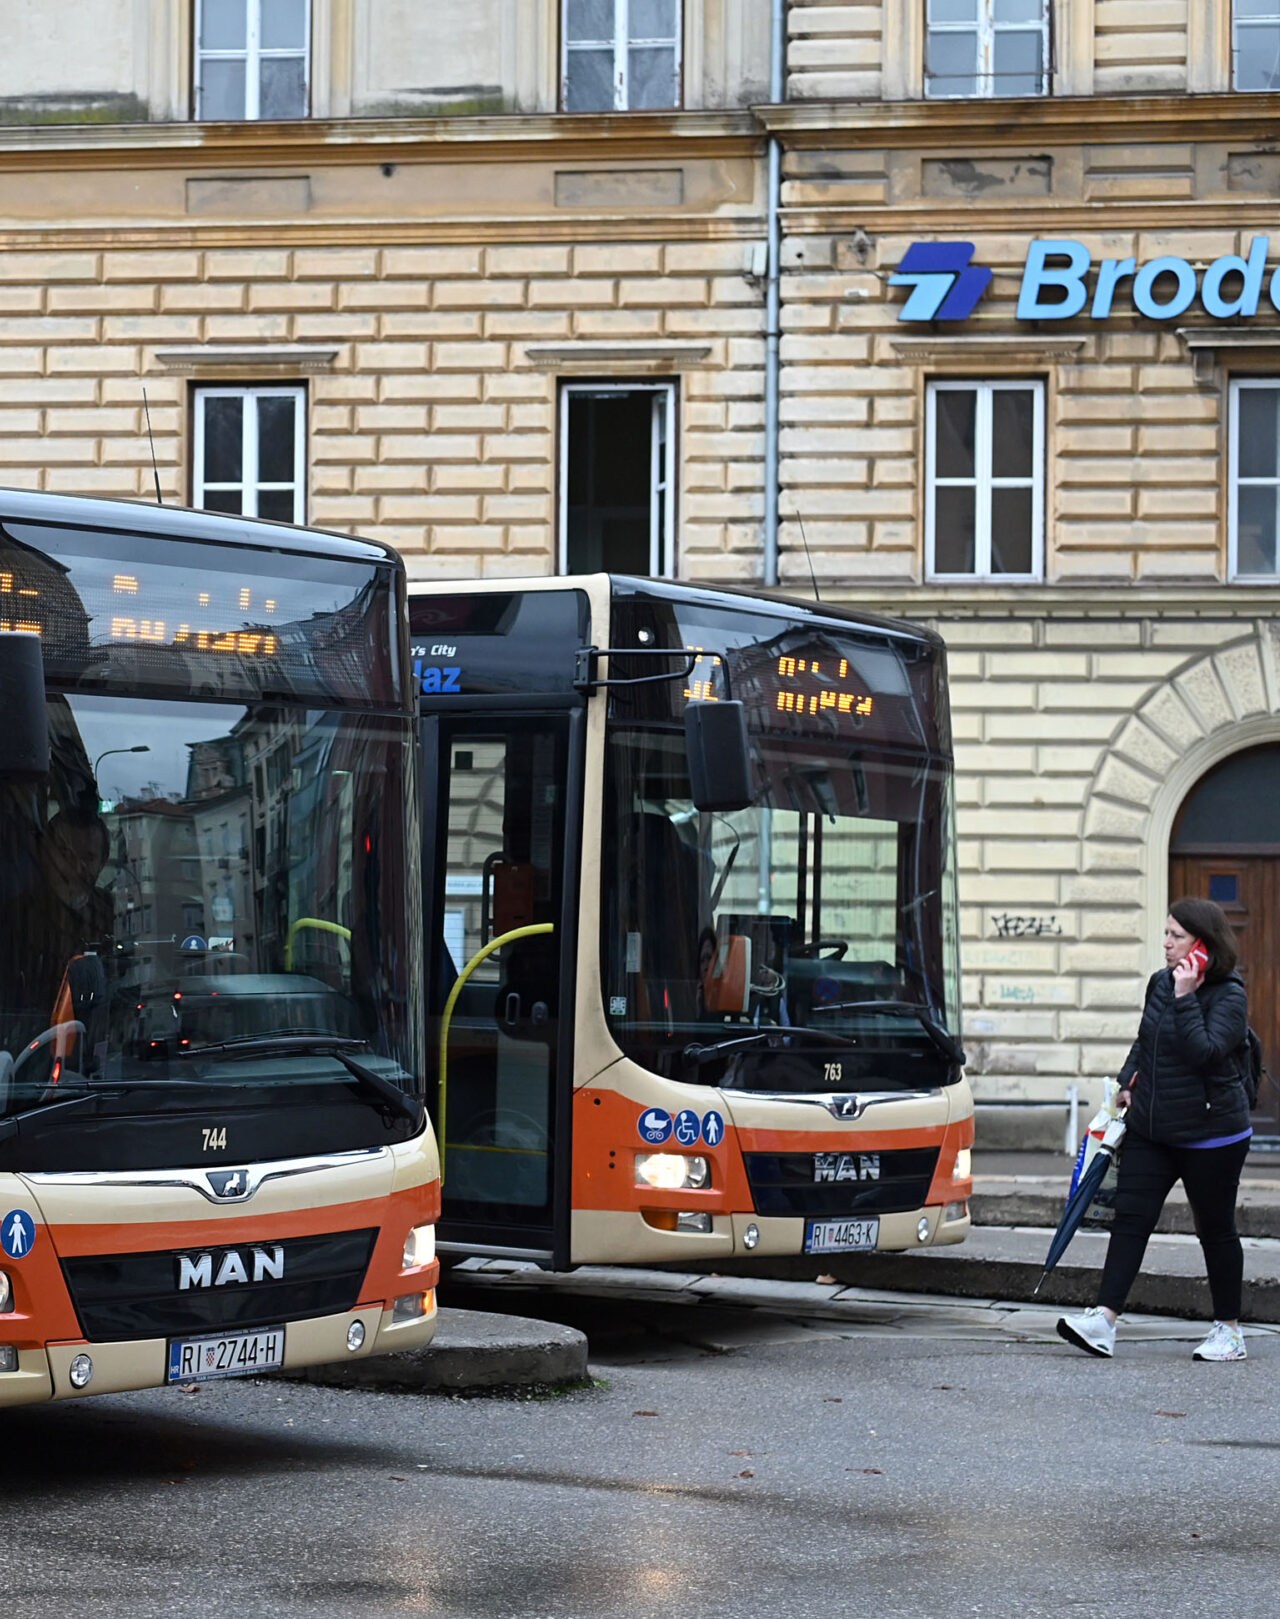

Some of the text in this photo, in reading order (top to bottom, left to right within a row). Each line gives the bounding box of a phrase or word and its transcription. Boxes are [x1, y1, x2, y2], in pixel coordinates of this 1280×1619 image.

[1016, 235, 1280, 320] Brod
[430, 644, 457, 657] City
[414, 659, 461, 693] laz
[824, 1063, 842, 1081] 763
[202, 1127, 227, 1151] 744
[813, 1152, 880, 1182] MAN
[176, 1245, 285, 1290] MAN
